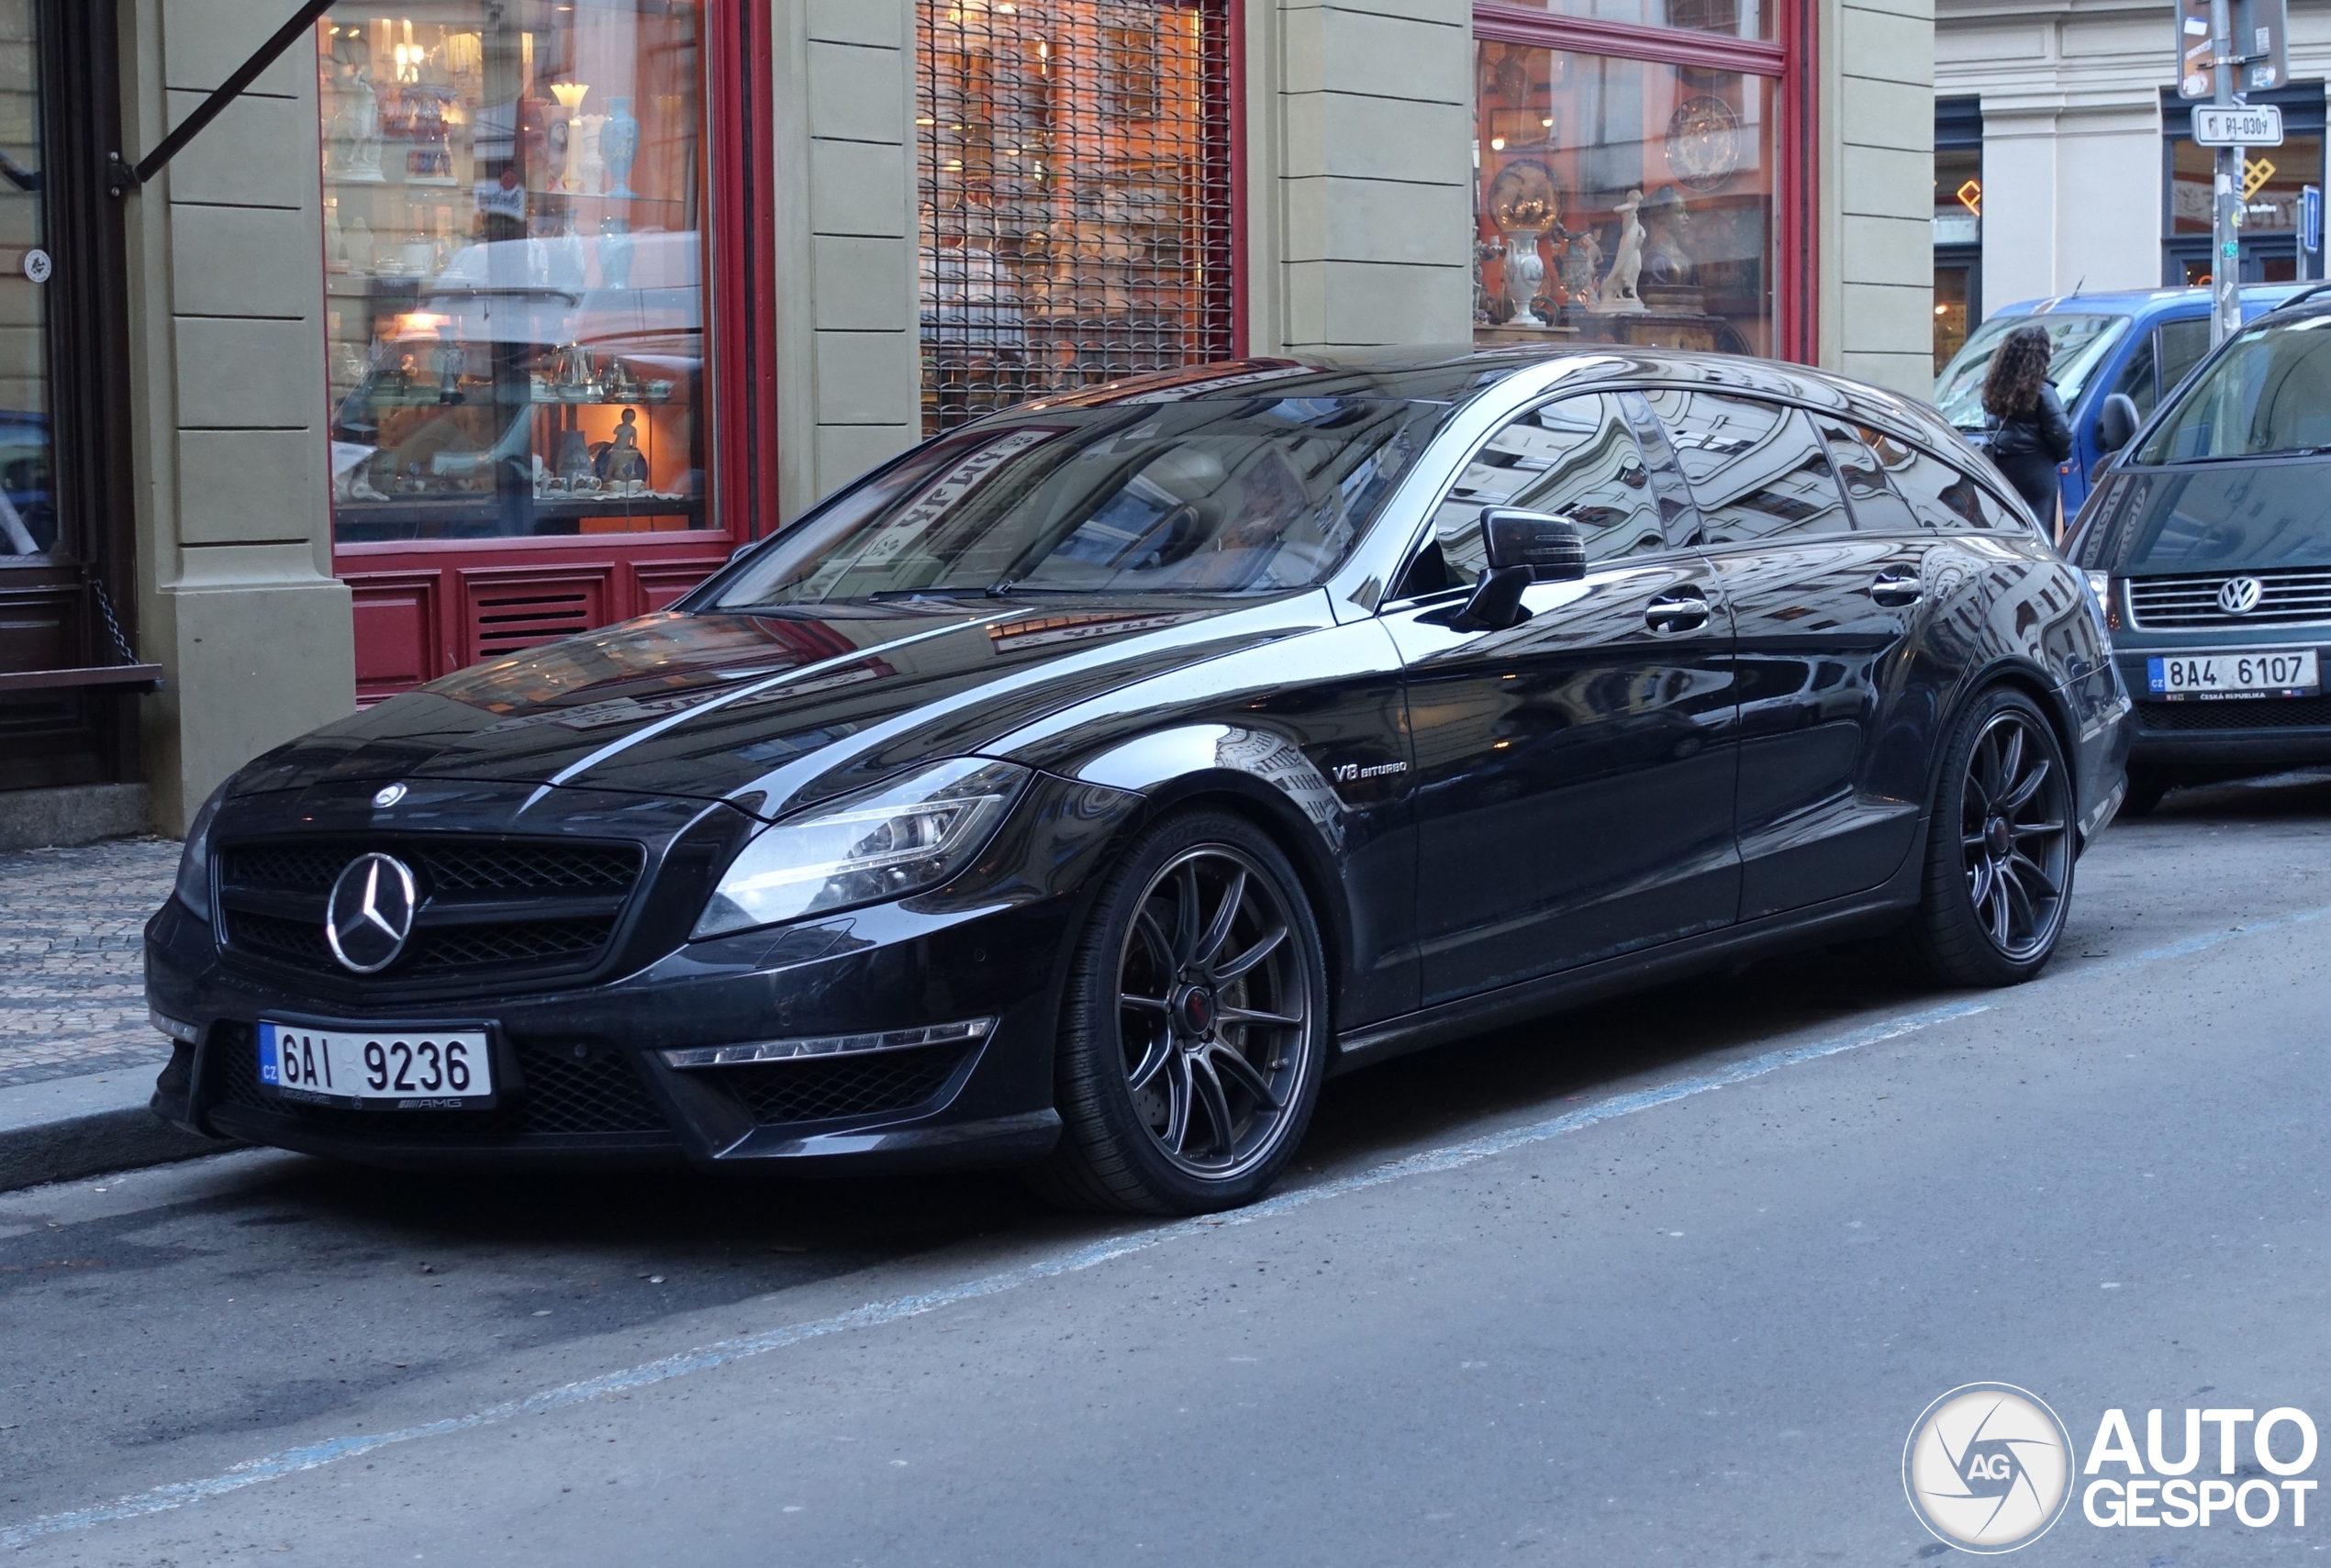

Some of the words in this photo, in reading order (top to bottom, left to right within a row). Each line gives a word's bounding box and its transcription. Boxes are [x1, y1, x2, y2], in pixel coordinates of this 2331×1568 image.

[2169, 660, 2217, 686] 8A4
[2237, 656, 2303, 684] 6107
[2151, 679, 2163, 688] CZ
[2200, 692, 2225, 700] ČESKÁ
[2225, 692, 2266, 700] REPUBLIKA
[1333, 763, 1358, 783] V8
[1360, 762, 1408, 779] BITURBO
[262, 1064, 278, 1081] CZ
[363, 1040, 470, 1091] 9236
